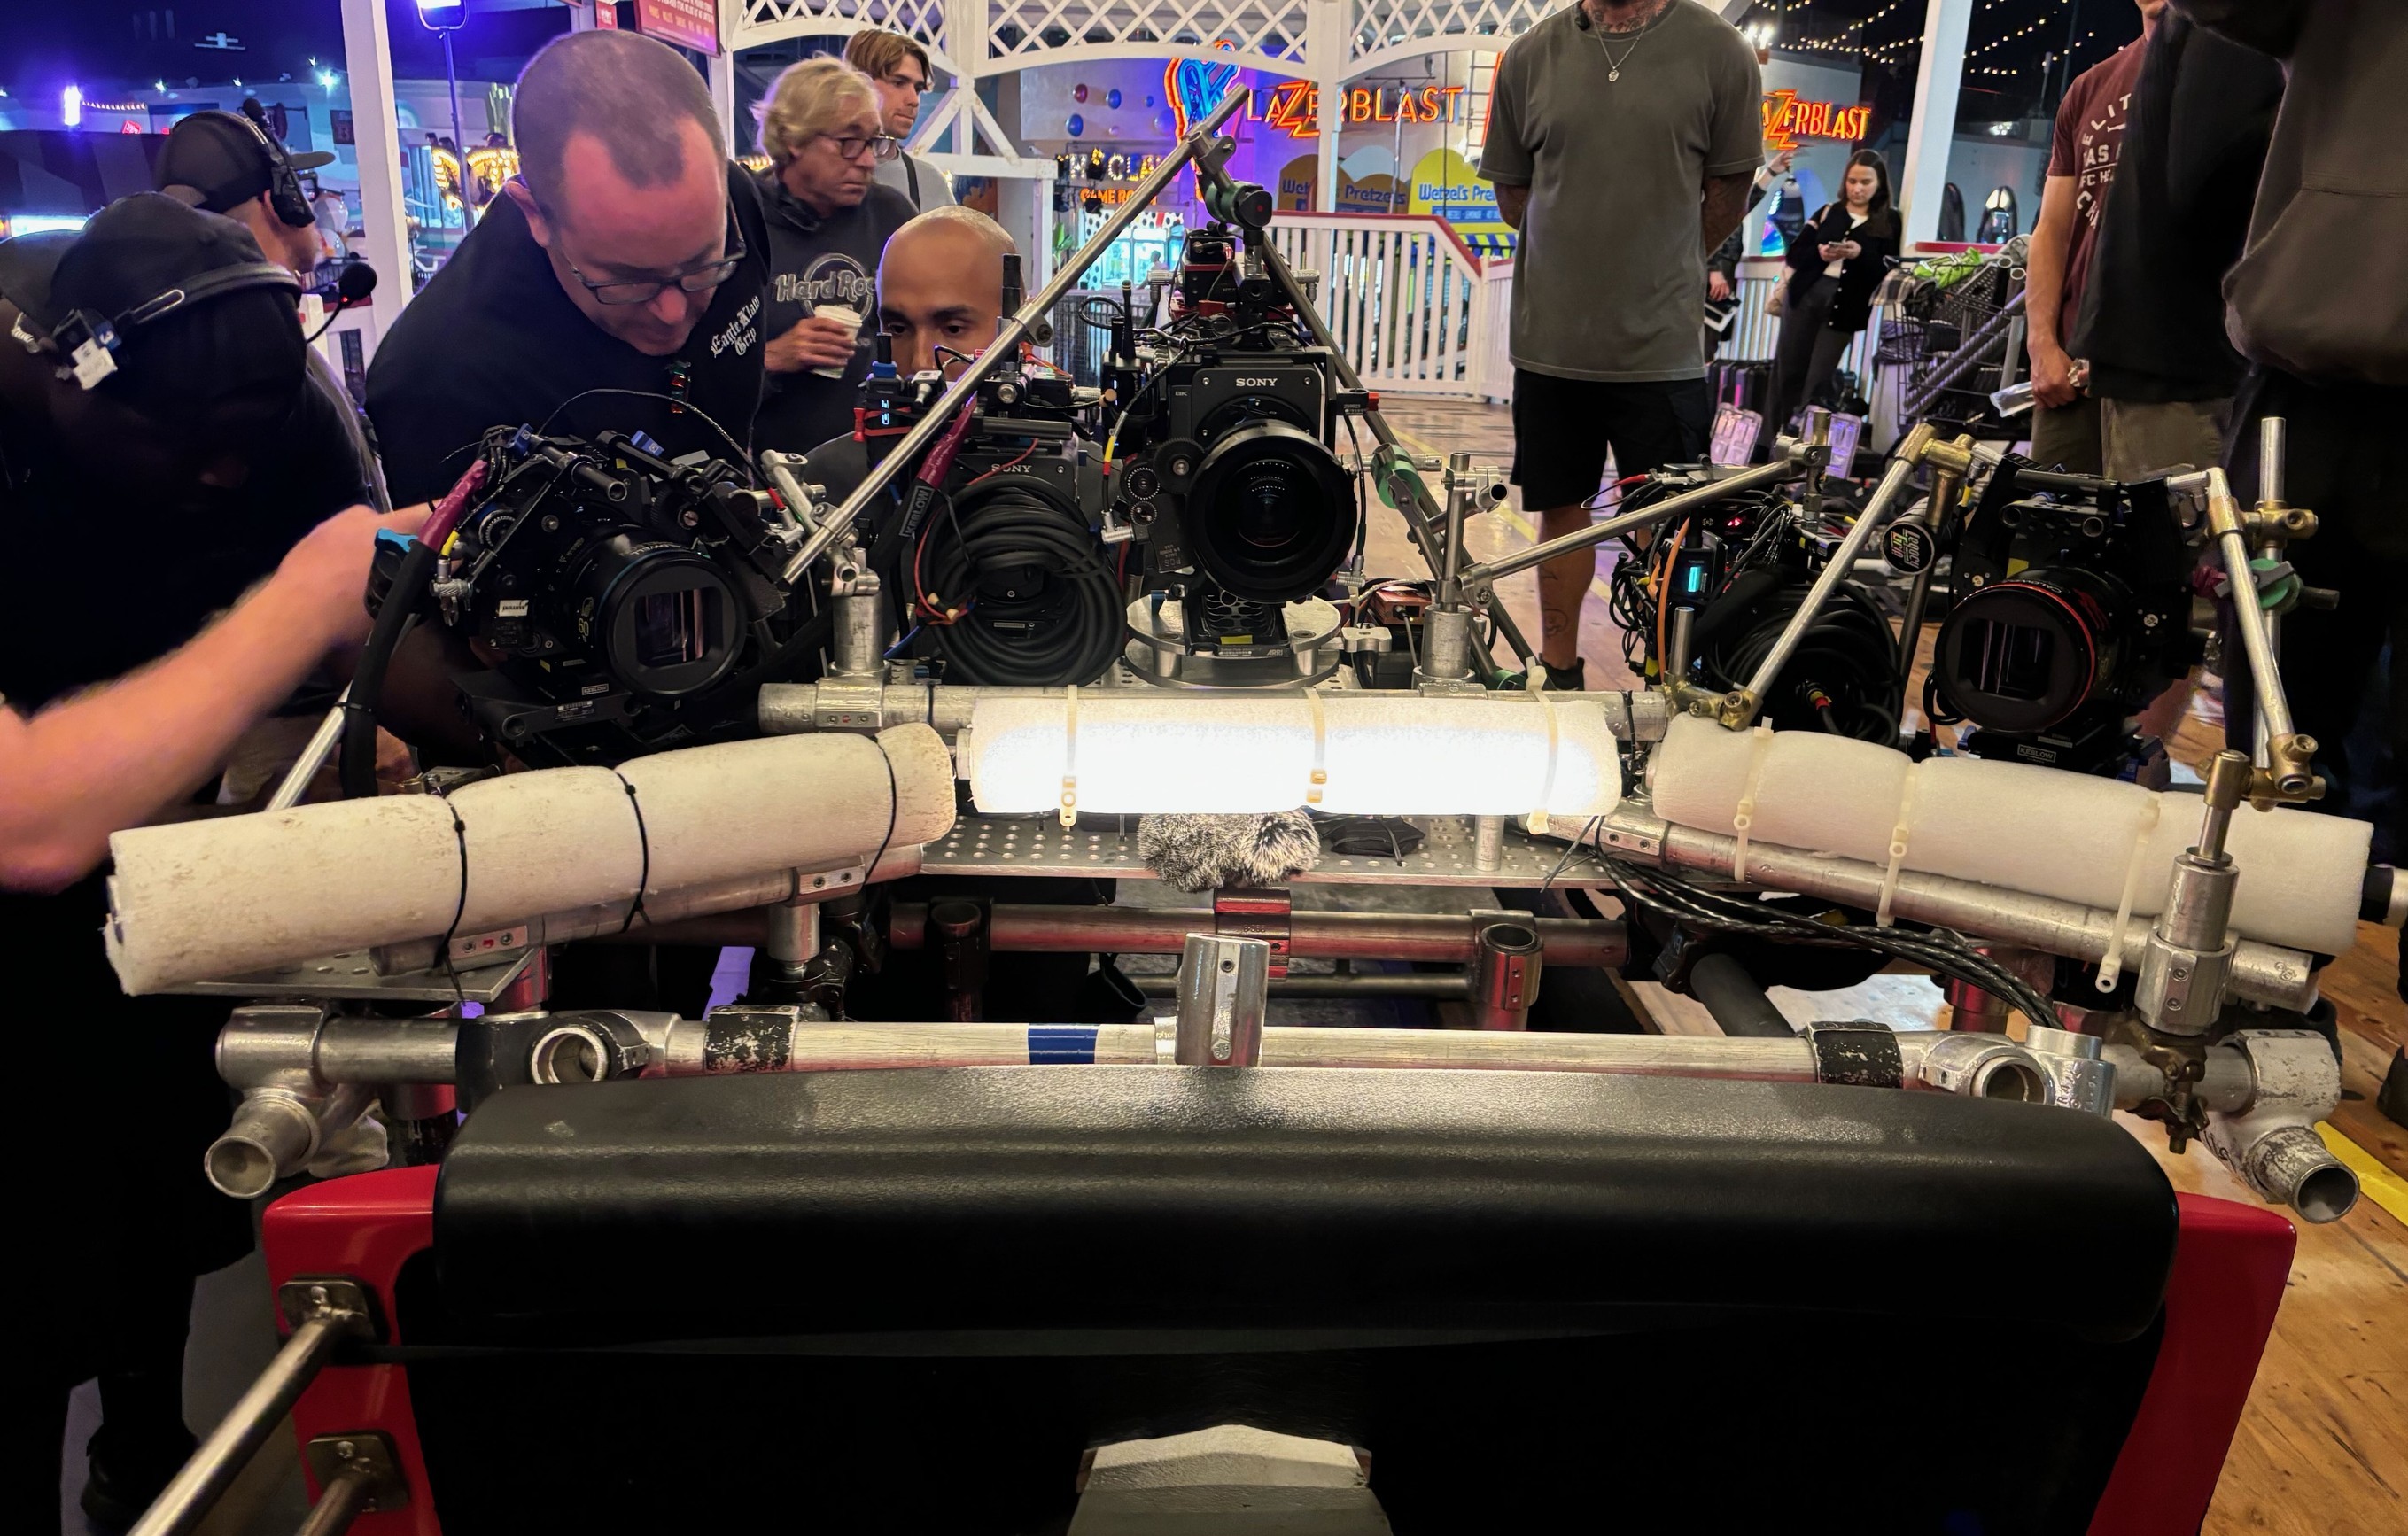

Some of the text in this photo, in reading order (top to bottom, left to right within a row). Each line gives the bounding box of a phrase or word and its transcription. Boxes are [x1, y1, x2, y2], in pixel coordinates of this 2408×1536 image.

[1761, 89, 1872, 151] AZERBLAST
[1107, 153, 1163, 182] CLA
[775, 270, 876, 302] Hard Roc
[711, 322, 741, 358] Eagle
[734, 327, 757, 356] Grip
[1235, 377, 1278, 387] SONY
